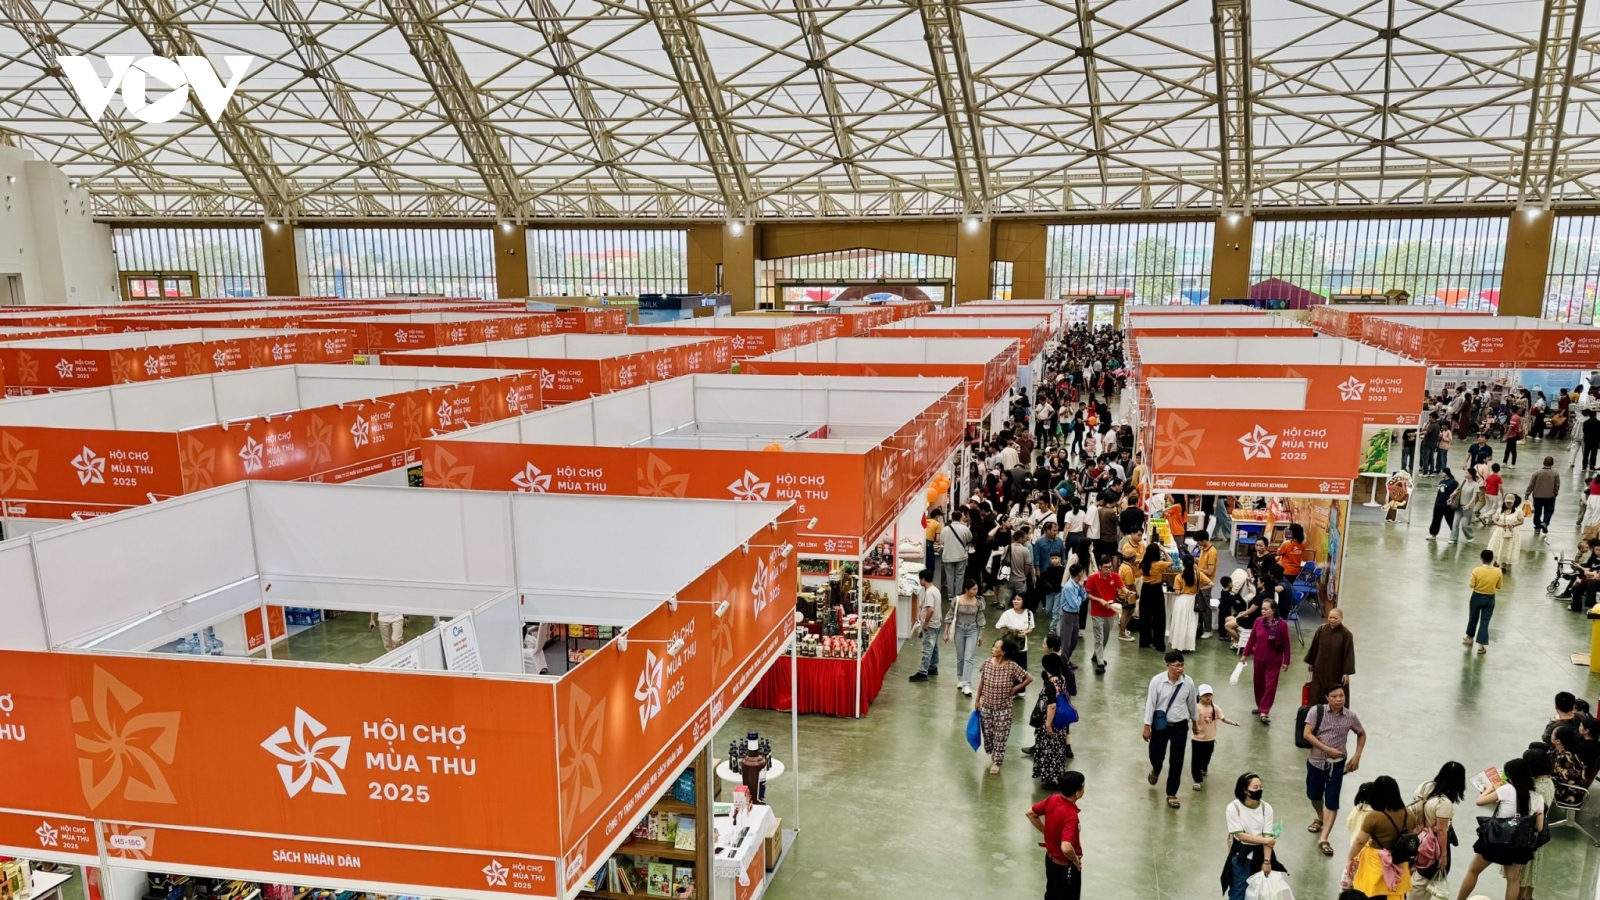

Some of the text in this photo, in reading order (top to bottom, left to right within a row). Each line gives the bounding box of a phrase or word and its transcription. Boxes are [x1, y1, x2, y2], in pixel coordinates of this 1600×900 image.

[1370, 377, 1382, 386] HỘI
[371, 411, 391, 422] HỘI CHỢ
[372, 422, 393, 432] MÙA THU
[1283, 427, 1327, 439] HỘI CHỢ
[266, 431, 291, 444] HỘI CHỢ
[1282, 438, 1328, 449] MÙA THU
[266, 443, 294, 455] MÙA THU
[110, 449, 149, 463] HỘI CHỢ
[111, 463, 153, 474] MÙA THU
[268, 458, 283, 468] 2025
[557, 465, 603, 480] HỘI CHỢ
[113, 478, 137, 486] 2025
[557, 479, 607, 492] MÙA THU
[776, 472, 825, 487] HỘI CHỢ
[776, 486, 828, 500] MÙA THU
[770, 558, 787, 583] MÙA THU
[680, 617, 695, 642] CHỢ
[667, 641, 697, 680] MÙA THU
[667, 675, 685, 704] 2025
[0, 724, 26, 741] HU
[363, 718, 466, 750] HỘI CHỢ
[366, 748, 476, 776] MÙA THU
[369, 782, 430, 803] 2025
[60, 824, 71, 833] HỘI
[606, 815, 618, 836] CÔNG
[62, 832, 76, 840] MÙA
[115, 838, 141, 846] H5-15C
[272, 849, 361, 868] SÁCH NHÂN DÂN
[512, 863, 543, 873] HỘI CHỢ
[513, 872, 529, 880] MÙA
